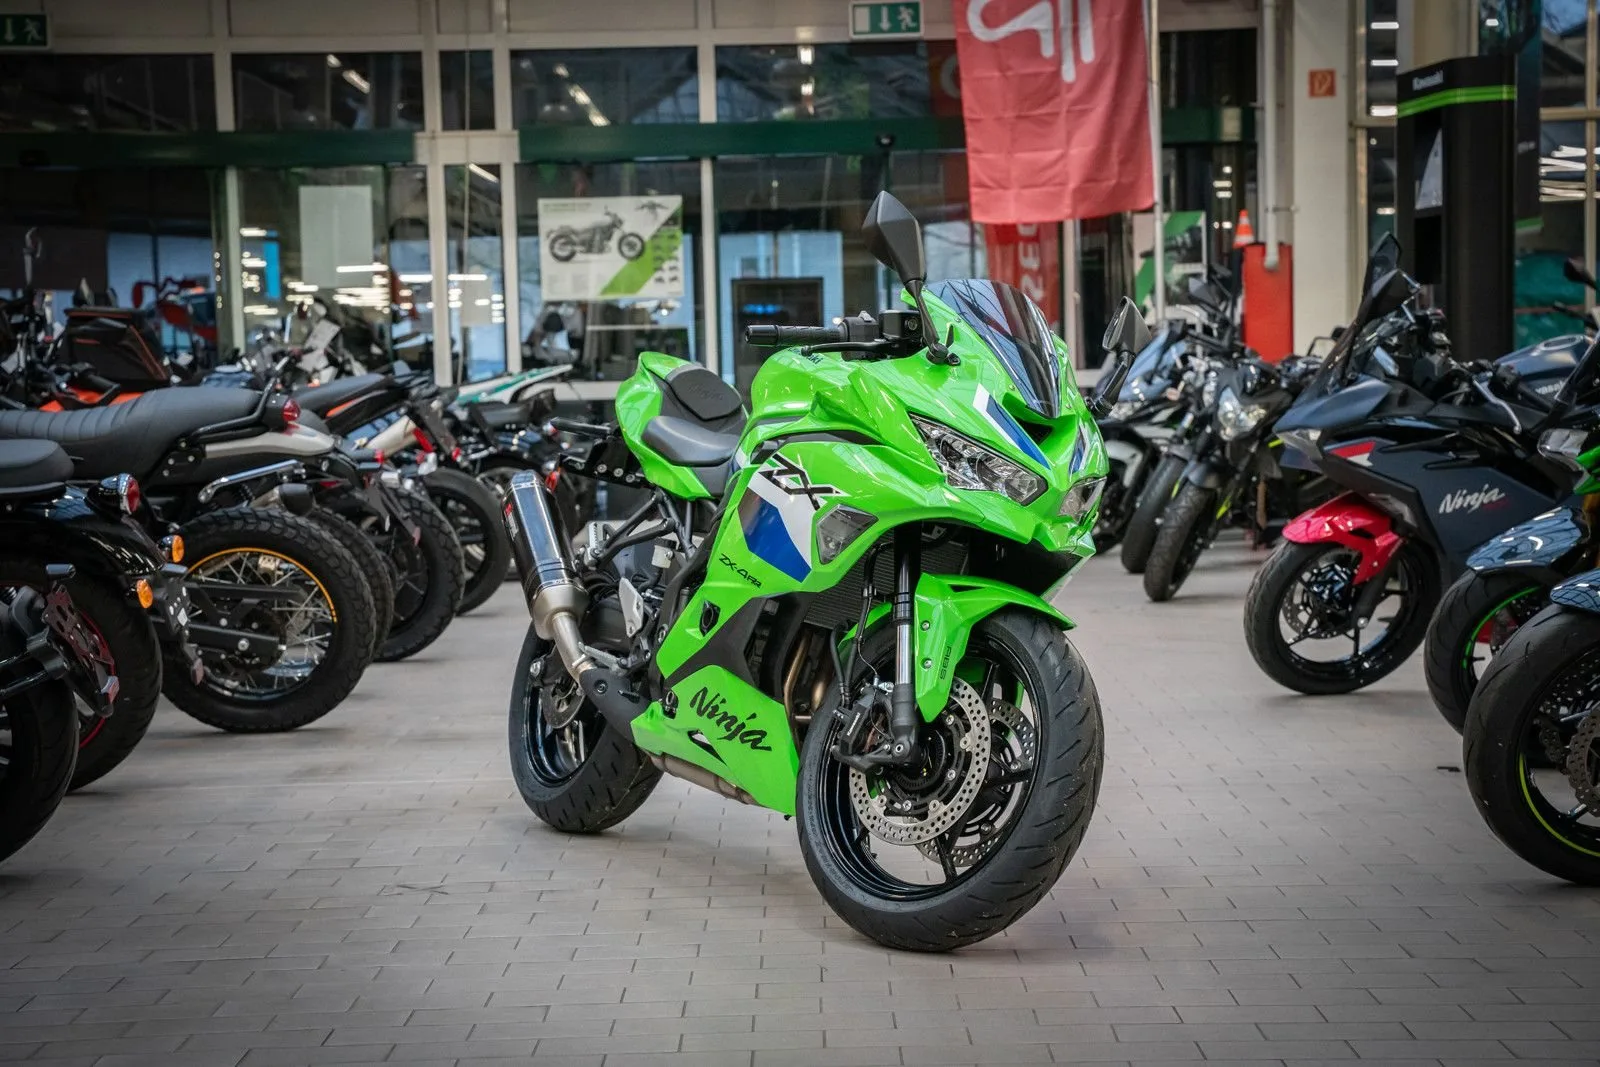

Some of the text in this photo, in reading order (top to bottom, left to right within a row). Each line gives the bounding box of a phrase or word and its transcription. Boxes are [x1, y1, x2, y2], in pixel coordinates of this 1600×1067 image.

[1438, 483, 1506, 514] Ninja
[940, 645, 952, 680] ABS
[689, 686, 773, 752] Ninja
